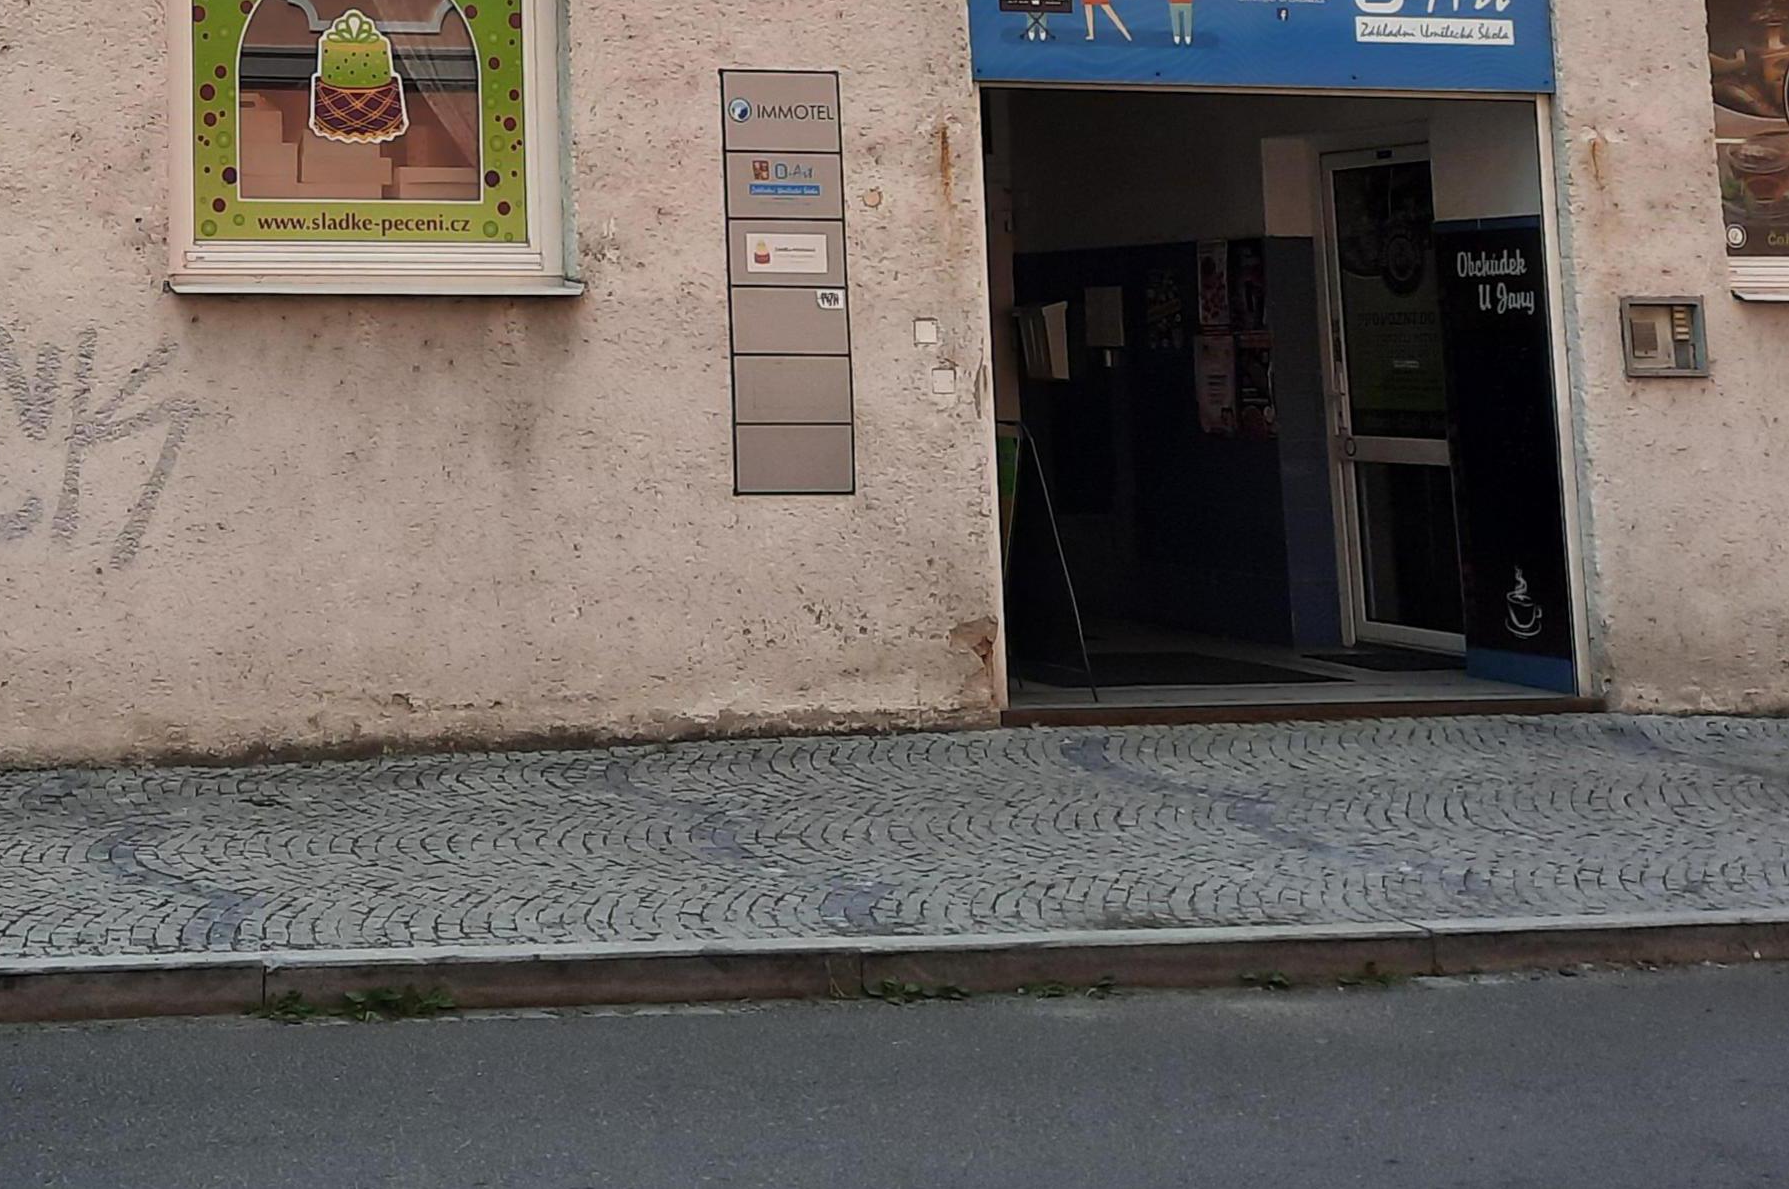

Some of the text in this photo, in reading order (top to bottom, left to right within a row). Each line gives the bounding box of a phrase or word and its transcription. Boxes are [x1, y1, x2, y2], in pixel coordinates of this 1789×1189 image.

[757, 104, 835, 121] IMMOTEL
[257, 212, 471, 237] www.sladke-peceni.cz
[1478, 282, 1535, 315] U Jany
